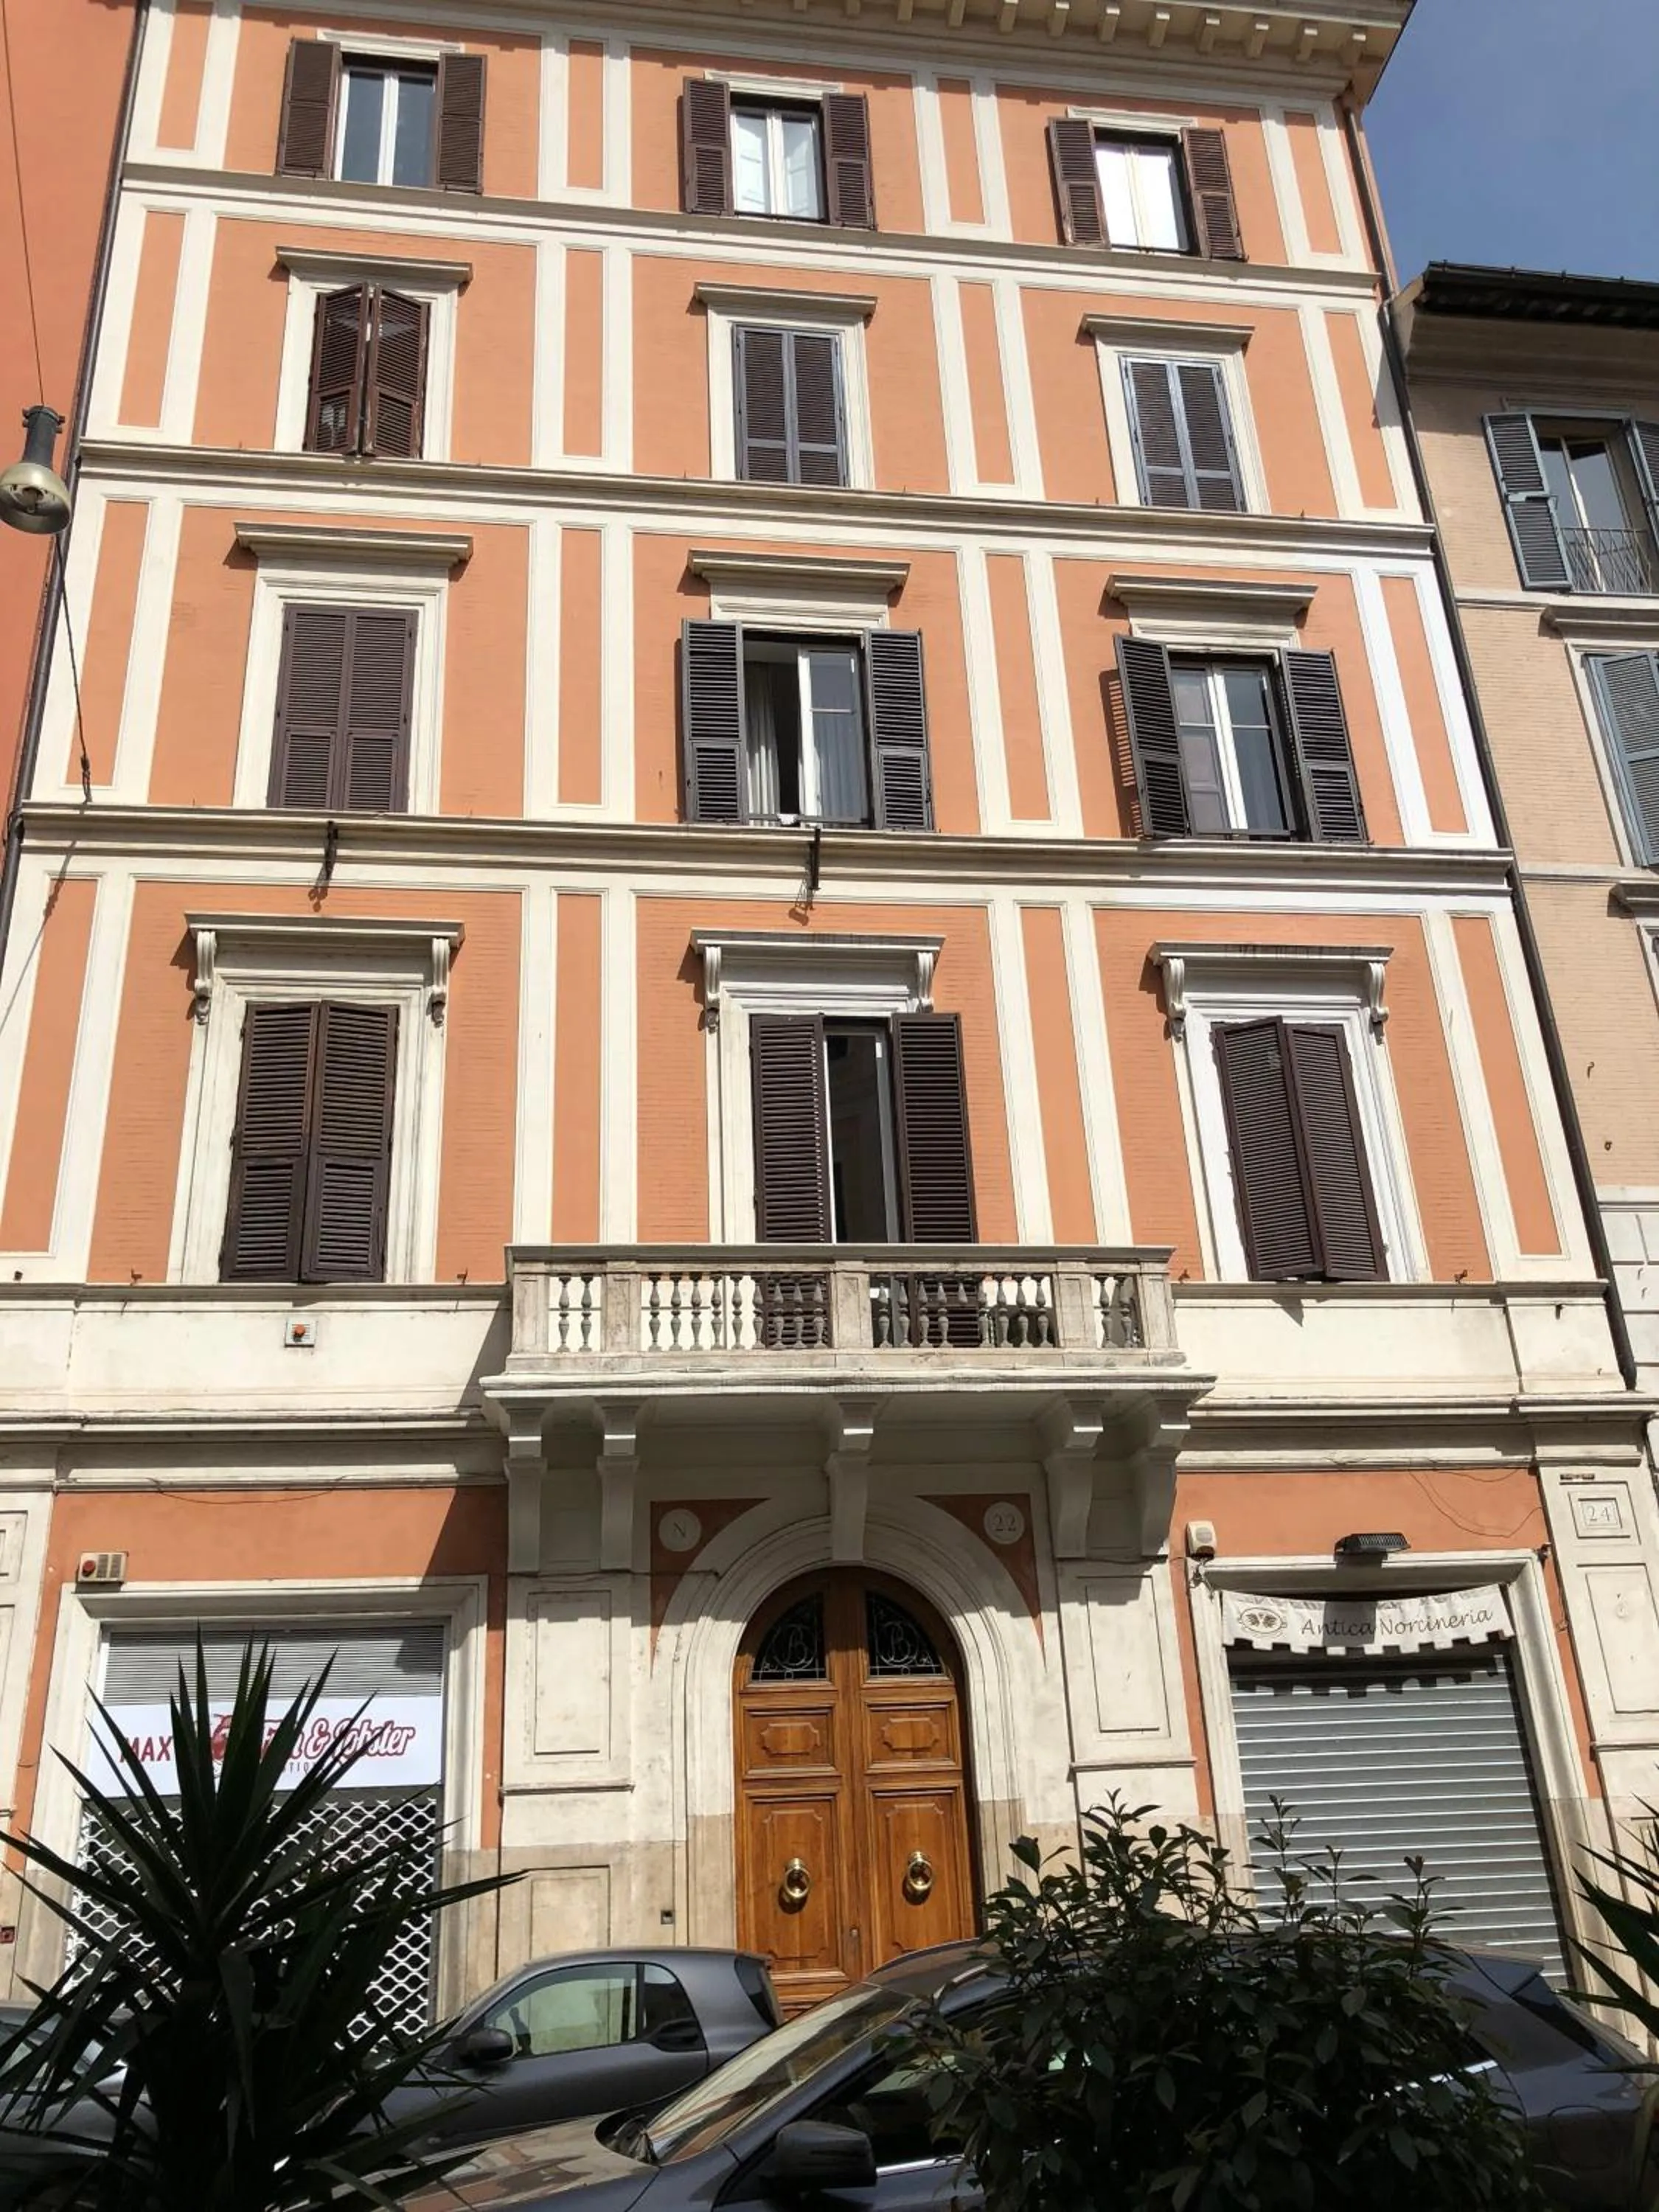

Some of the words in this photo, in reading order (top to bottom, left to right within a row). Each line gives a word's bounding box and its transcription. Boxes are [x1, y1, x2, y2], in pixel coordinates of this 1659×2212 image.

[993, 1512, 1017, 1532] 22
[1585, 1504, 1613, 1523] 24
[1301, 1619, 1375, 1636] Antica
[1380, 1607, 1493, 1635] Norcineria
